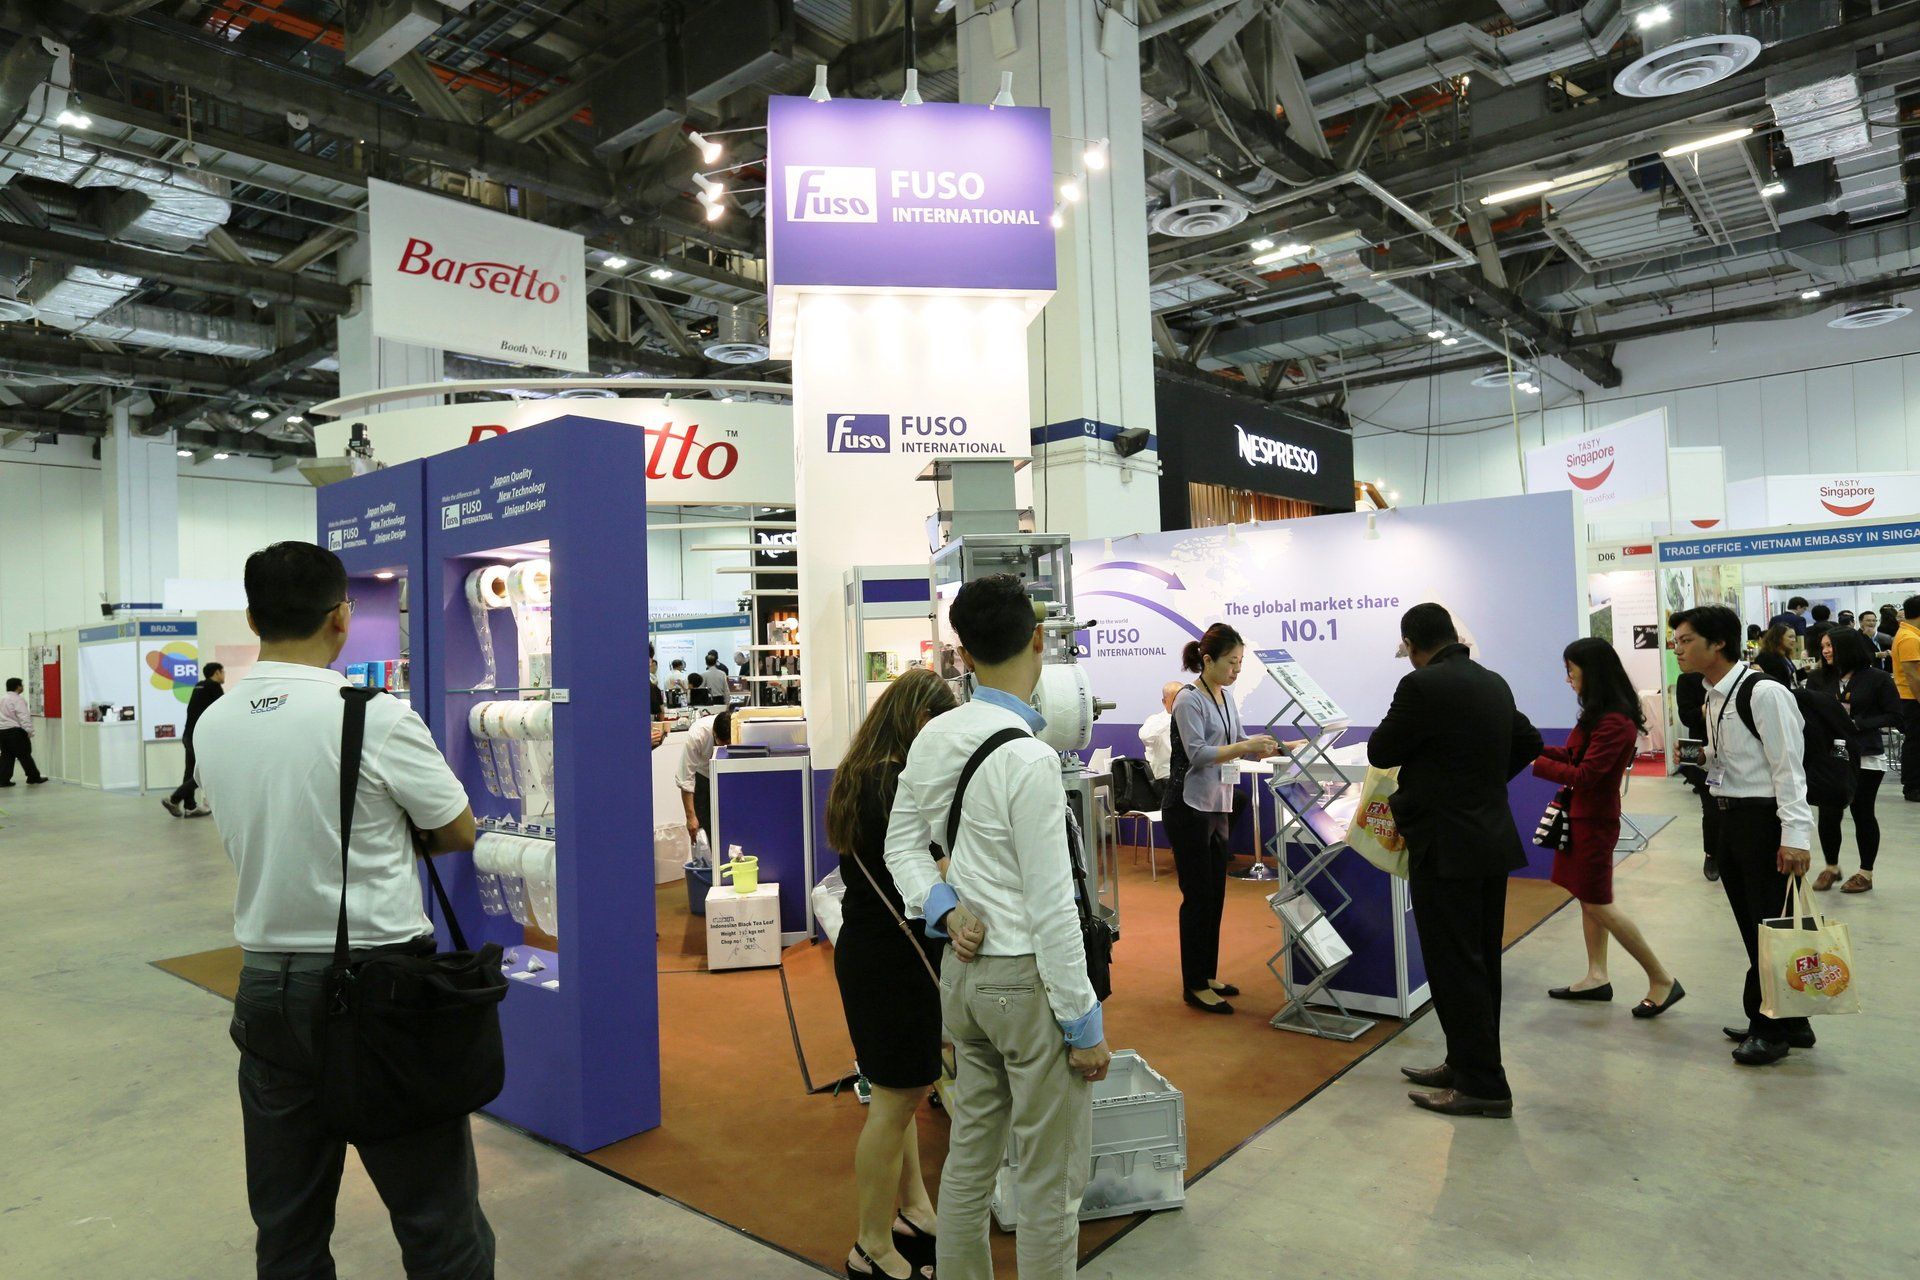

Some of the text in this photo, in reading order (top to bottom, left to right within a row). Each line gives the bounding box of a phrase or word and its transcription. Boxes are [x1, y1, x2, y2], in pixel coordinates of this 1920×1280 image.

[891, 170, 985, 200] FUSO
[893, 207, 1040, 225] INTERNATIONAL
[398, 238, 560, 304] Barsetto
[501, 340, 568, 361] Booth No: F10
[901, 416, 968, 436] FUSO
[1084, 421, 1097, 436] C2
[901, 442, 1006, 453] INTERNATIONAL
[1233, 424, 1319, 475] NESPRESSO
[1577, 438, 1601, 451] TASTY
[1566, 445, 1615, 468] Singapore
[493, 468, 533, 487] Japan Quality
[1834, 479, 1861, 487] TASTY
[498, 482, 546, 501] New Technology
[1820, 486, 1875, 499] Singapore
[461, 500, 482, 516] FUSO
[504, 499, 546, 516] Unique Design
[461, 512, 494, 526] INTERNATIONAL
[343, 527, 359, 541] FUSO
[1665, 545, 1700, 557] TRADE
[1702, 542, 1742, 555] OFFICE
[1751, 537, 1801, 550] VIETNAM
[1804, 533, 1862, 546] EMBASSY
[1866, 531, 1879, 542] IN
[1597, 552, 1616, 562] D06
[1225, 595, 1399, 618] The global market share
[150, 625, 178, 633] BRAZIL
[1097, 628, 1140, 644] FUSO
[1281, 618, 1338, 642] NO.1
[1097, 647, 1167, 657] INTERNATIONAL
[250, 697, 279, 709] VIP
